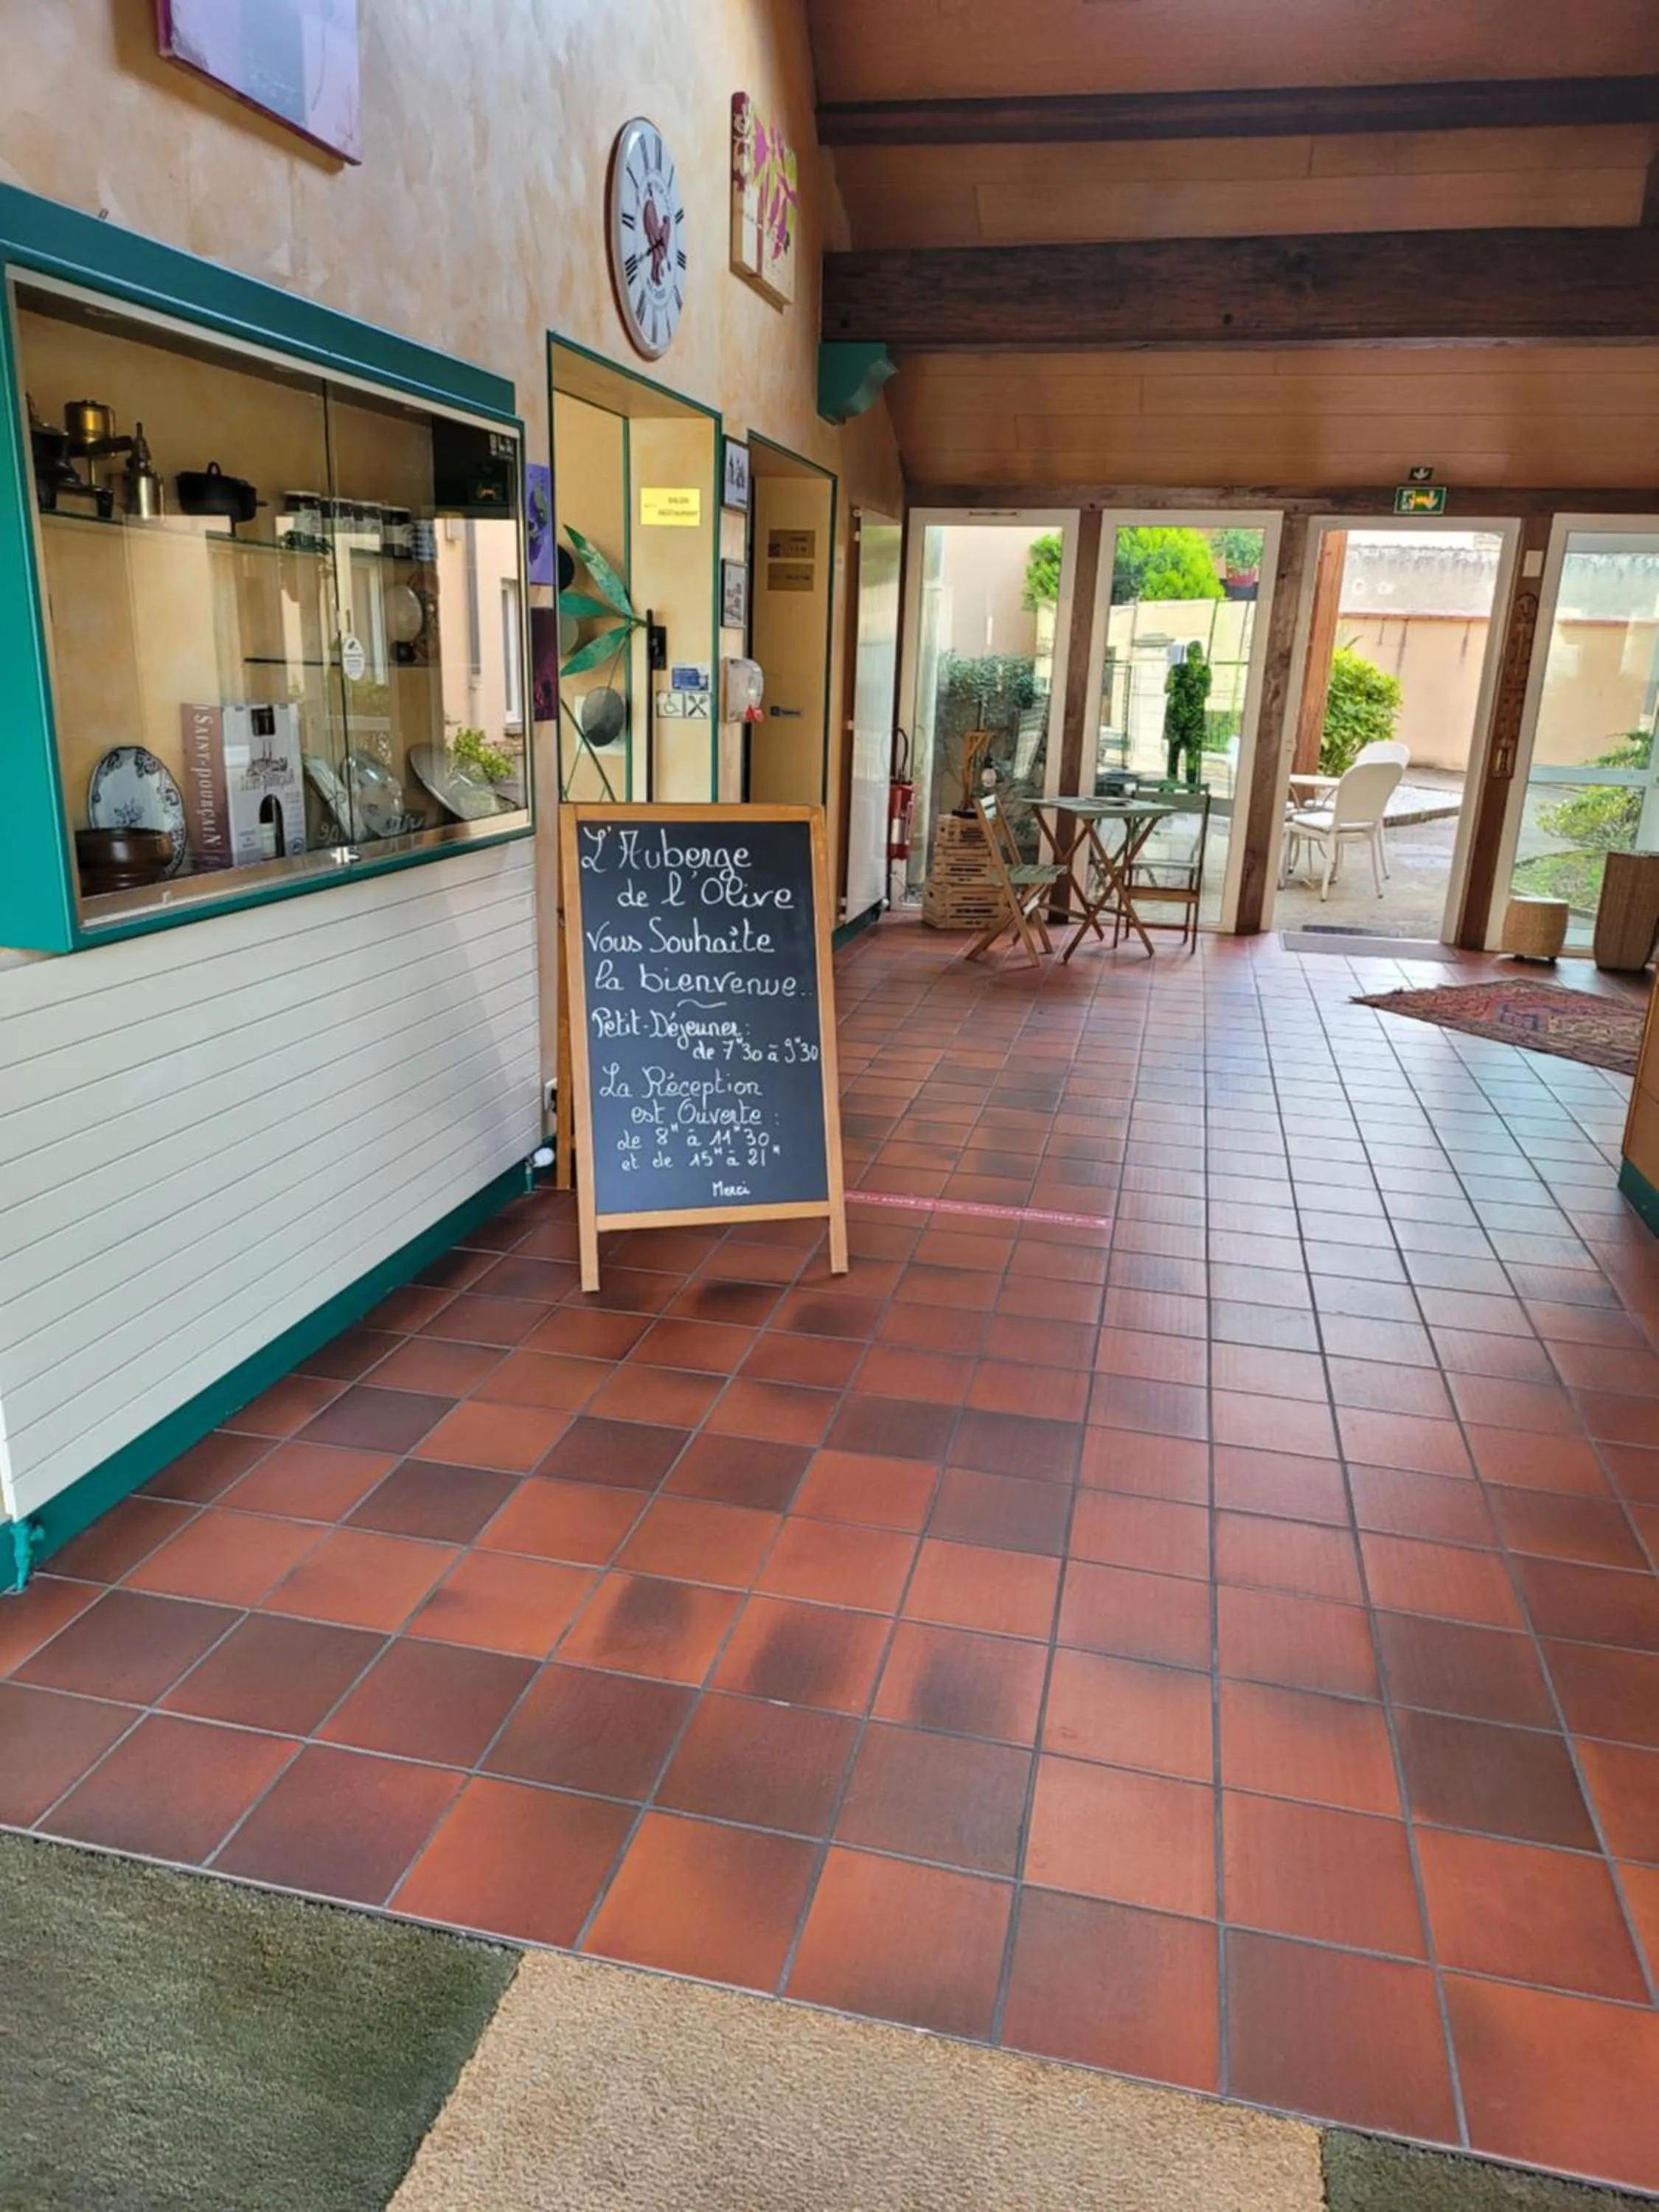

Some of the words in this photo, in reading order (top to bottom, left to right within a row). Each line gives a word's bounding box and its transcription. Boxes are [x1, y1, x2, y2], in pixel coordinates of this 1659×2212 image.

[580, 825, 752, 882] L'Auberge
[616, 877, 650, 908] de
[586, 920, 644, 953] Vous
[594, 959, 625, 990] la
[692, 1039, 715, 1060] de
[599, 1062, 633, 1098] La
[641, 1065, 764, 1110] Réception
[630, 1099, 666, 1124] est
[616, 1129, 643, 1151] de
[620, 1152, 640, 1171] et
[652, 1150, 674, 1169] de
[712, 1180, 752, 1198] Merci
